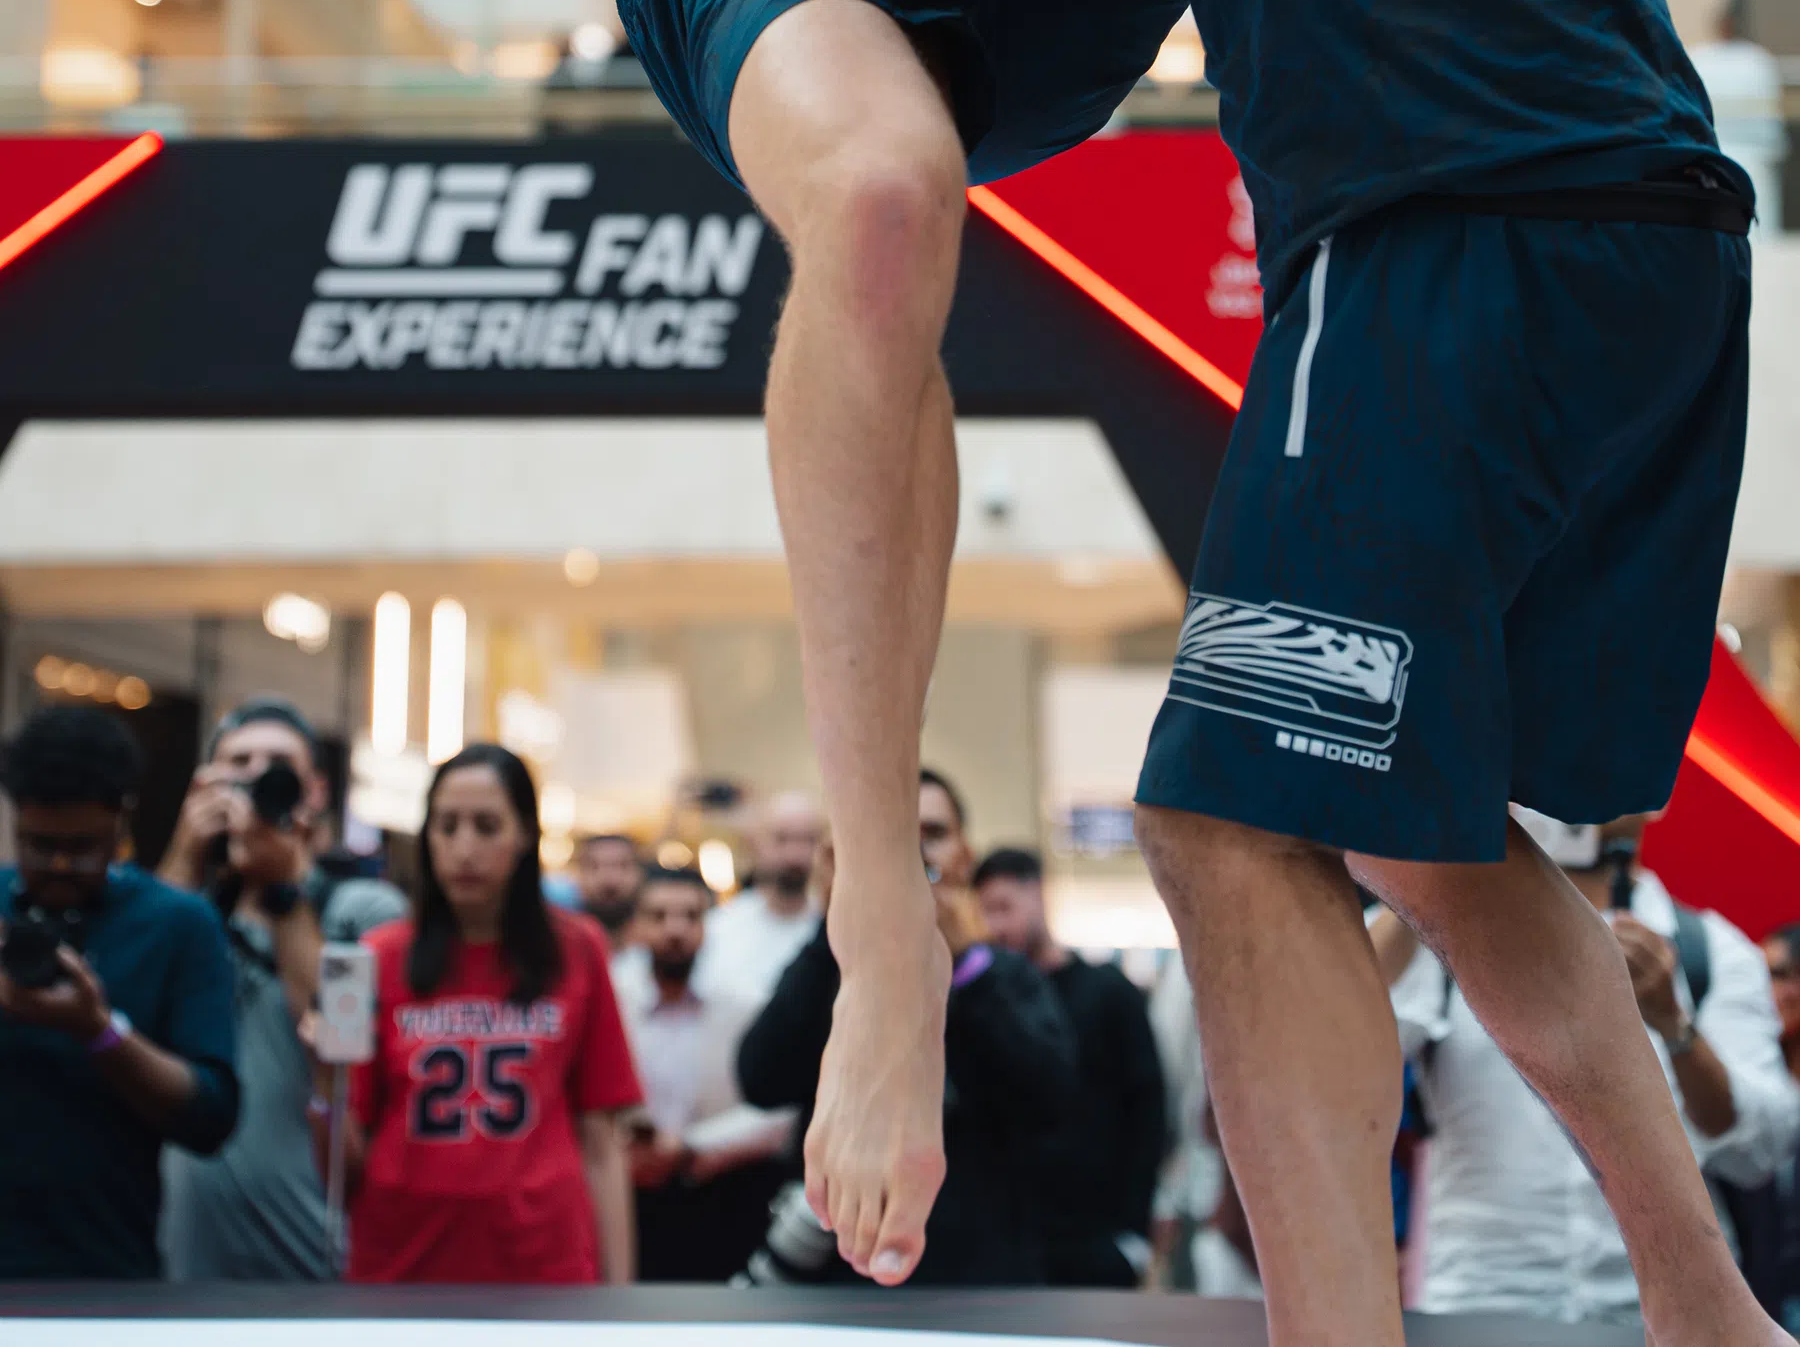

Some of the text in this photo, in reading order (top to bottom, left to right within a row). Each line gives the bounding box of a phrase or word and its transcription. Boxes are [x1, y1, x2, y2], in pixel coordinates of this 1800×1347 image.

[327, 163, 761, 295] UFC FAN
[291, 299, 737, 370] EXPERIENCE
[411, 1041, 534, 1139] 25
